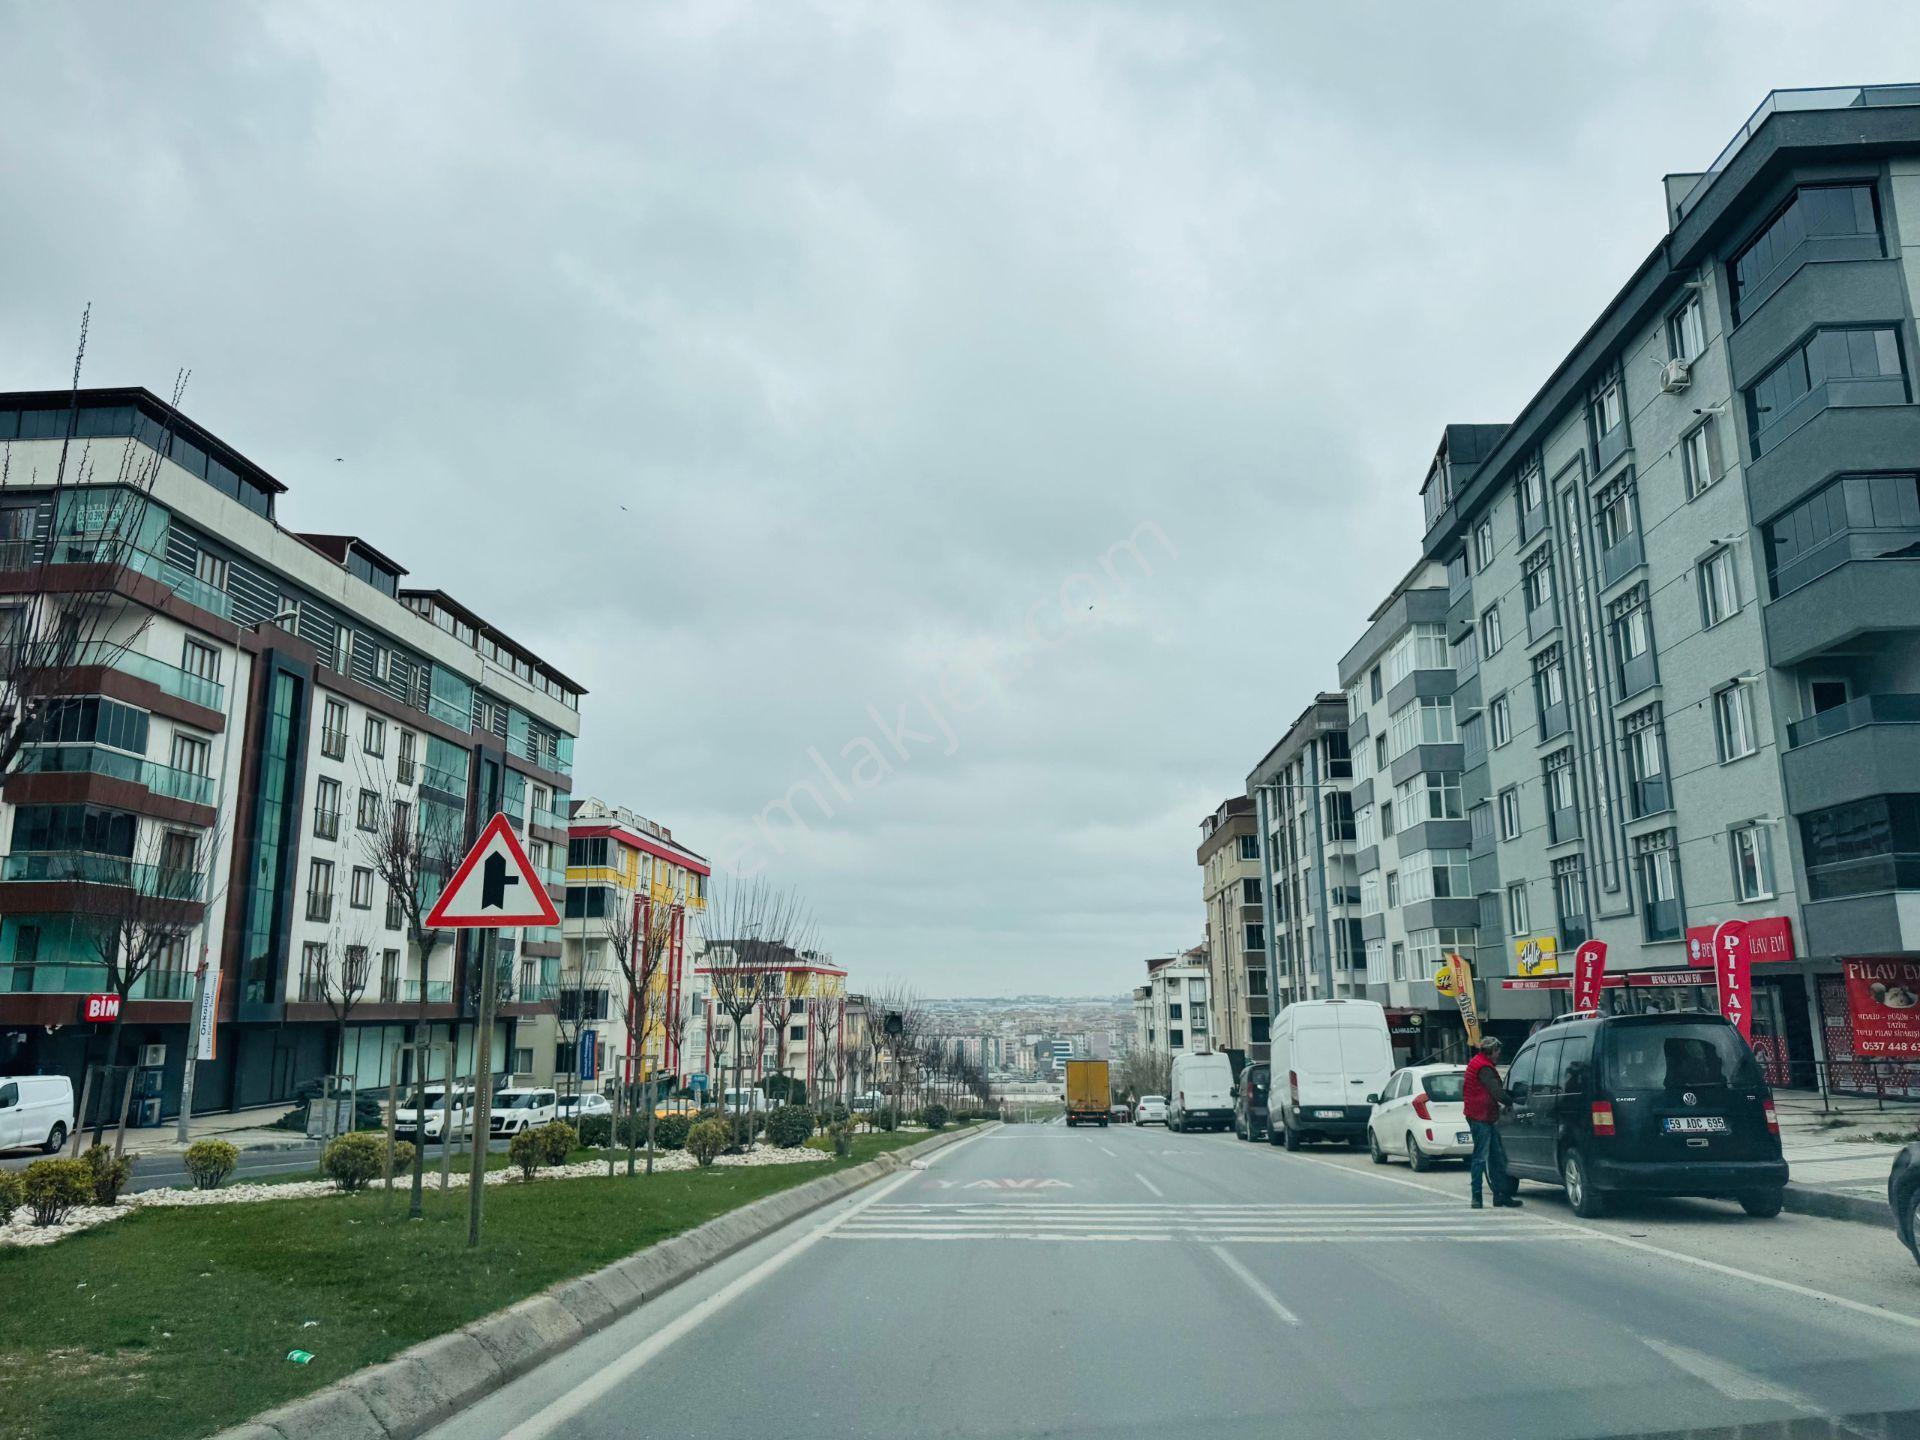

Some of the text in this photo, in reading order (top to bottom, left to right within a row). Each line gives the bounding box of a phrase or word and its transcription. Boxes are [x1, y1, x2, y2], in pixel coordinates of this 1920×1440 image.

[1749, 936, 1768, 954] İLAV
[1848, 961, 1897, 980] PİLAV
[89, 996, 120, 1017] BİM
[201, 993, 210, 1035] Onkoloji
[1862, 1042, 1885, 1051] 0537
[1887, 1042, 1908, 1051] 448
[1670, 1118, 1724, 1129] 59 ADC 695
